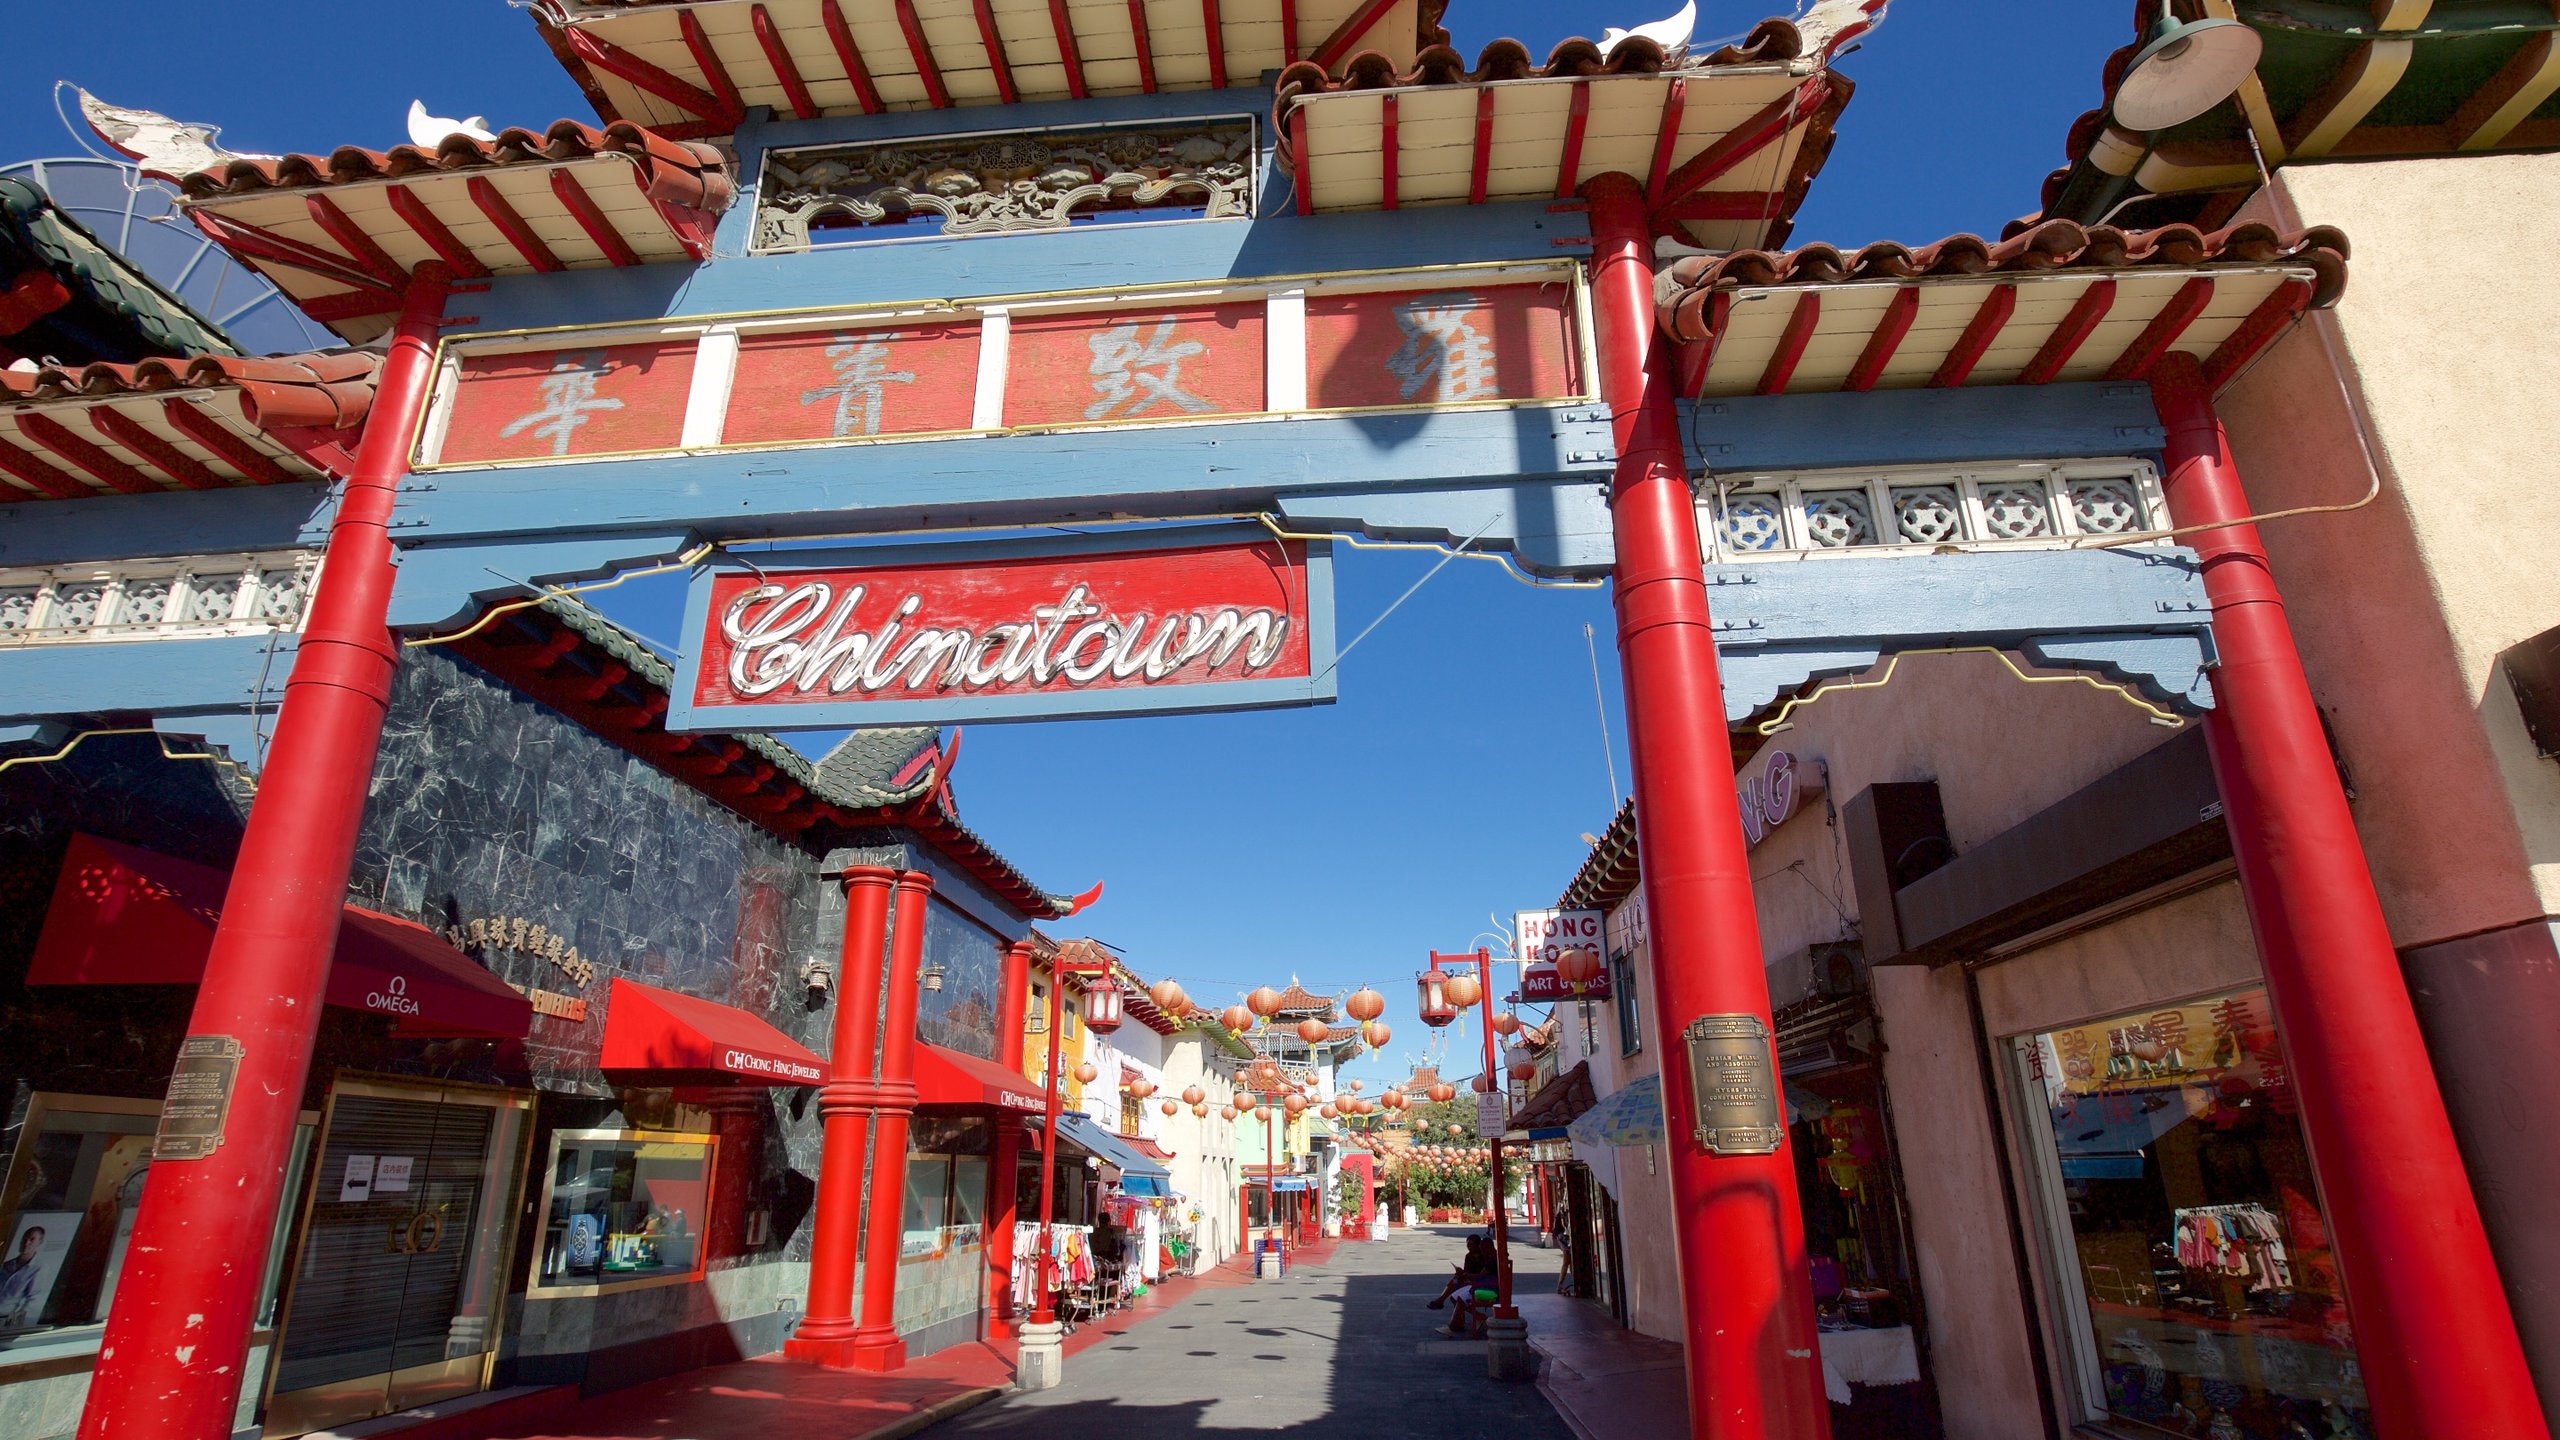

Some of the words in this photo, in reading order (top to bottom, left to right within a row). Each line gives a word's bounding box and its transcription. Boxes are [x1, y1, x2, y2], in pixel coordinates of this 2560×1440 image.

[719, 580, 1296, 697] Chinatown
[1736, 749, 1793, 844] NG
[1524, 917, 1598, 939] HONG
[1618, 895, 1647, 957] HO
[1525, 943, 1600, 964] KOG
[1528, 976, 1554, 992] ART
[1560, 975, 1606, 990] GDS
[366, 991, 419, 1016] OMEGA
[744, 1054, 772, 1073] CHONG
[772, 1059, 791, 1076] HING
[790, 1063, 820, 1080] JEWELERS
